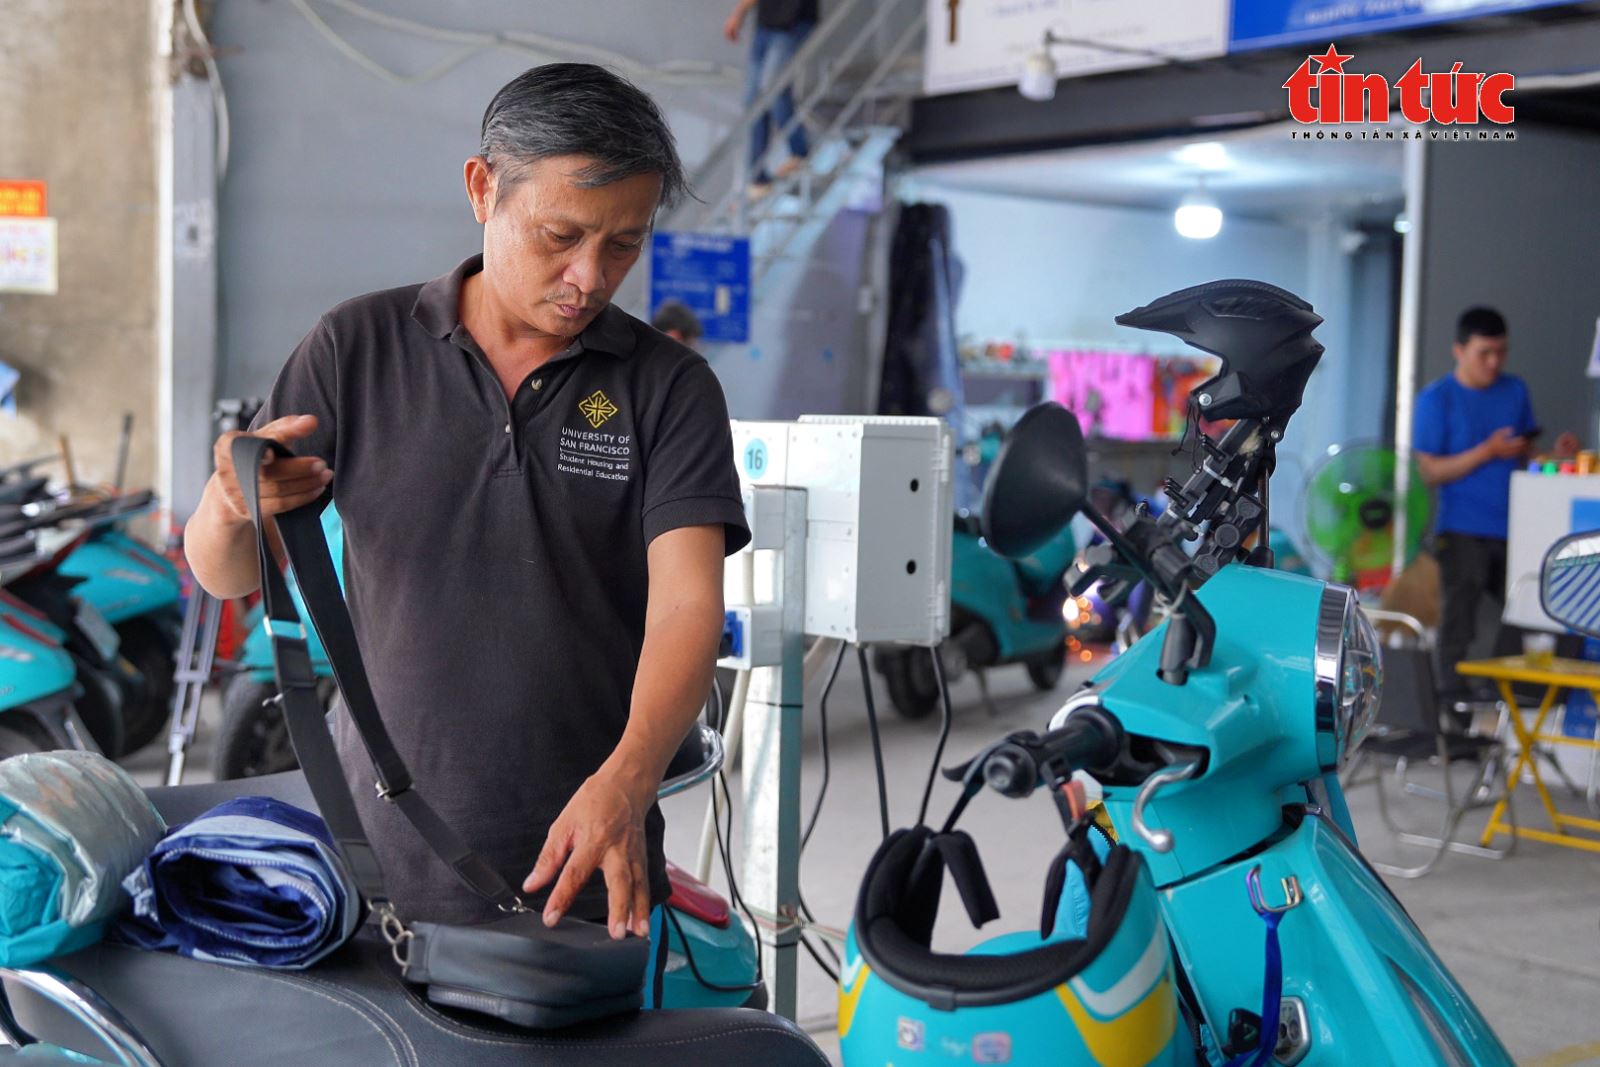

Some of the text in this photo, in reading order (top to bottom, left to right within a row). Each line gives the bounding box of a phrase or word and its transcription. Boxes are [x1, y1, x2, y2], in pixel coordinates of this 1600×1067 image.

[562, 426, 630, 444] UNIVERSITY OF
[560, 438, 630, 455] SAN FRANCISCO
[559, 453, 585, 464] Student
[587, 459, 613, 469] Housing
[747, 449, 763, 470] 16
[557, 463, 629, 481] Residential Education
